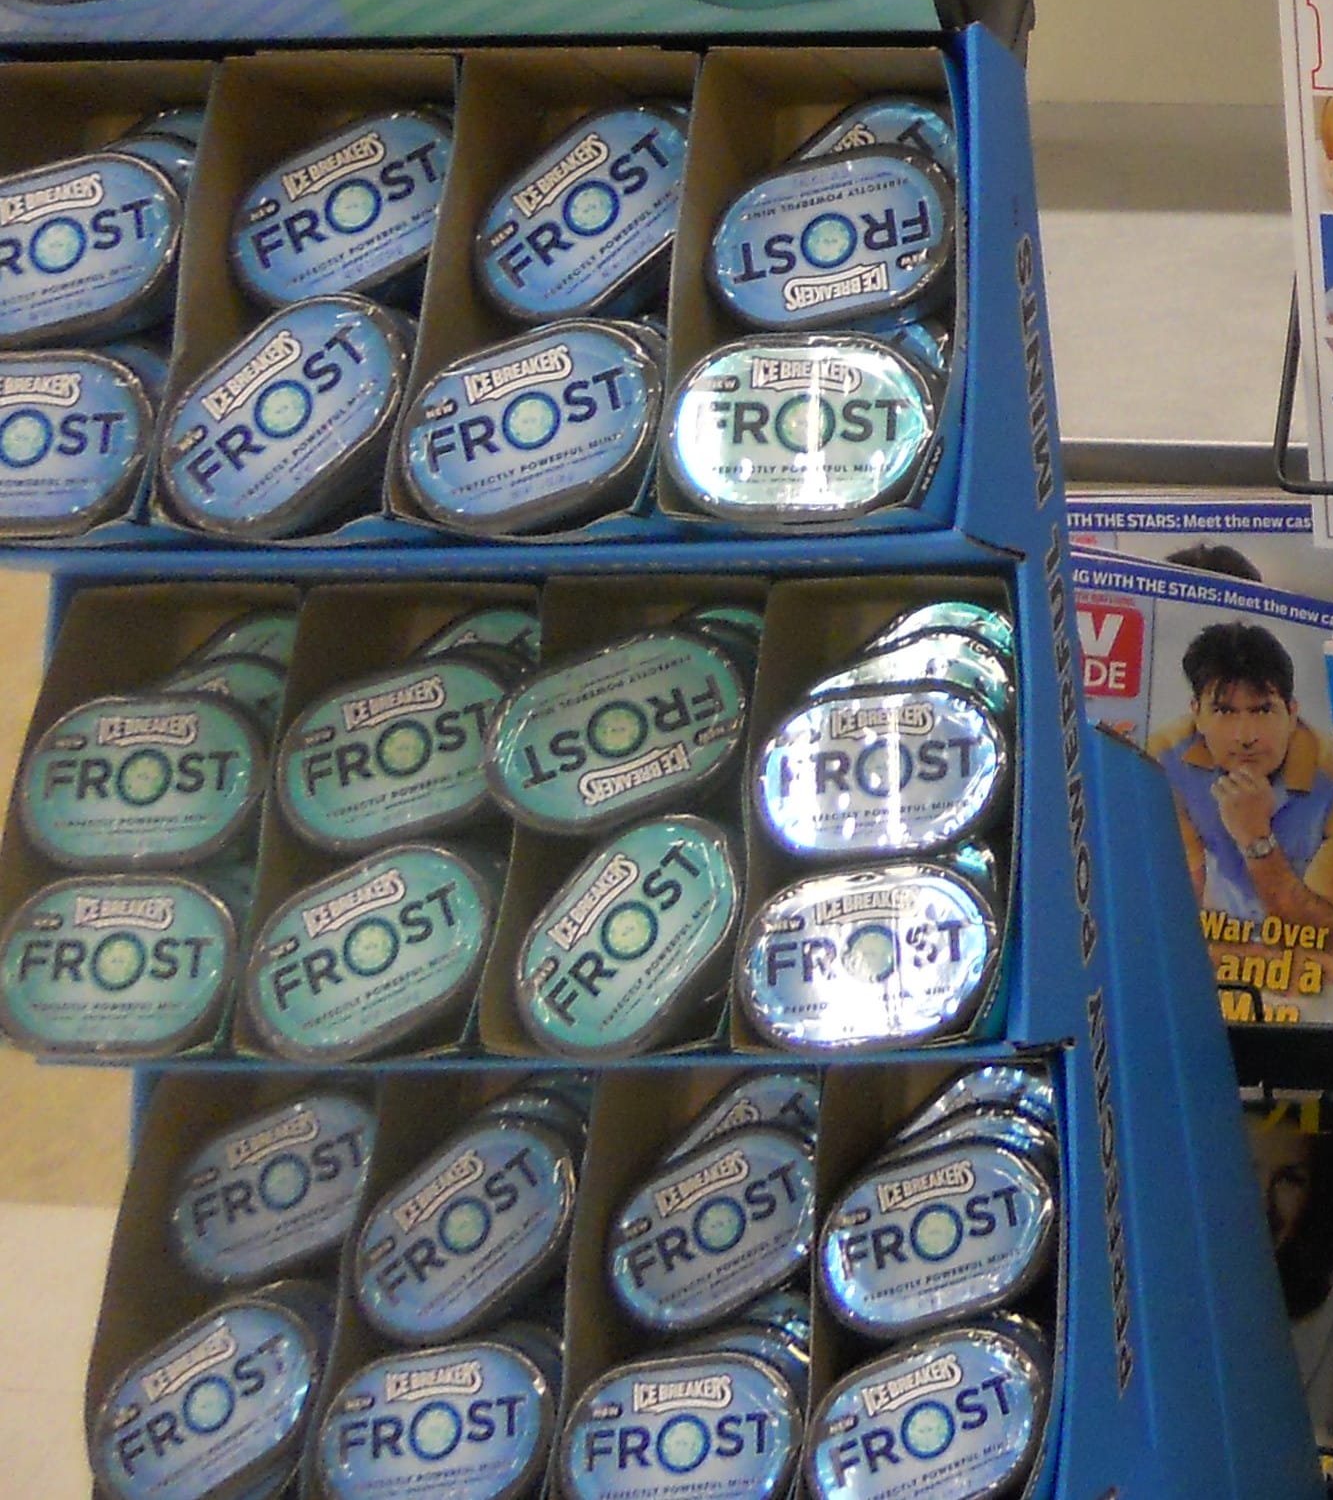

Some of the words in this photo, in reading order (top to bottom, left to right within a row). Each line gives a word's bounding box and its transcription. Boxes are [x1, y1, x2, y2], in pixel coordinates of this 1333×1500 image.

[708, 394, 908, 452] FROST
[41, 747, 238, 803] FROST
[839, 1186, 1021, 1269] FROST
